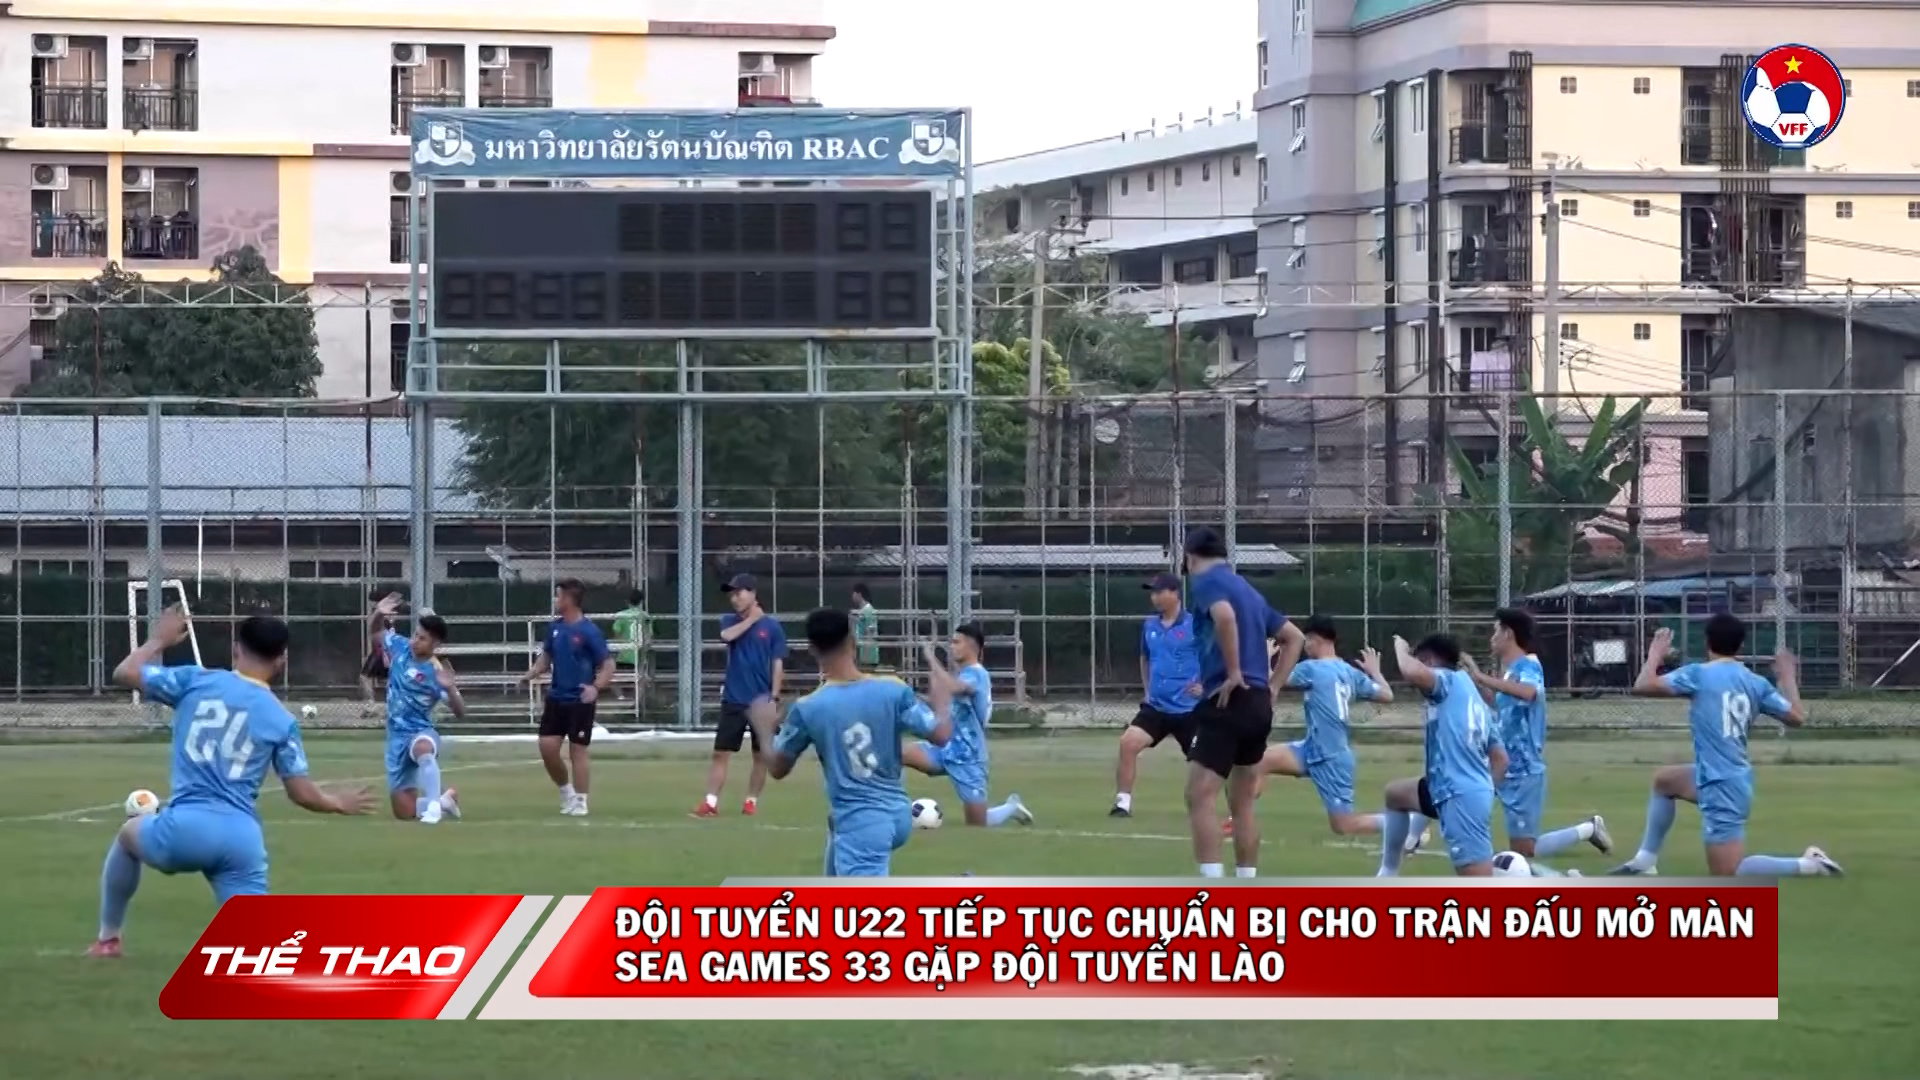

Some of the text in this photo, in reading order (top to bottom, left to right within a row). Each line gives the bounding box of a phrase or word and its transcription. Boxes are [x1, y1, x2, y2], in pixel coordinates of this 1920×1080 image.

[484, 128, 890, 161] มหาวิทยาลัยรัตนบัณฑิต RBAC
[184, 699, 255, 780] 24
[843, 721, 879, 779] 2
